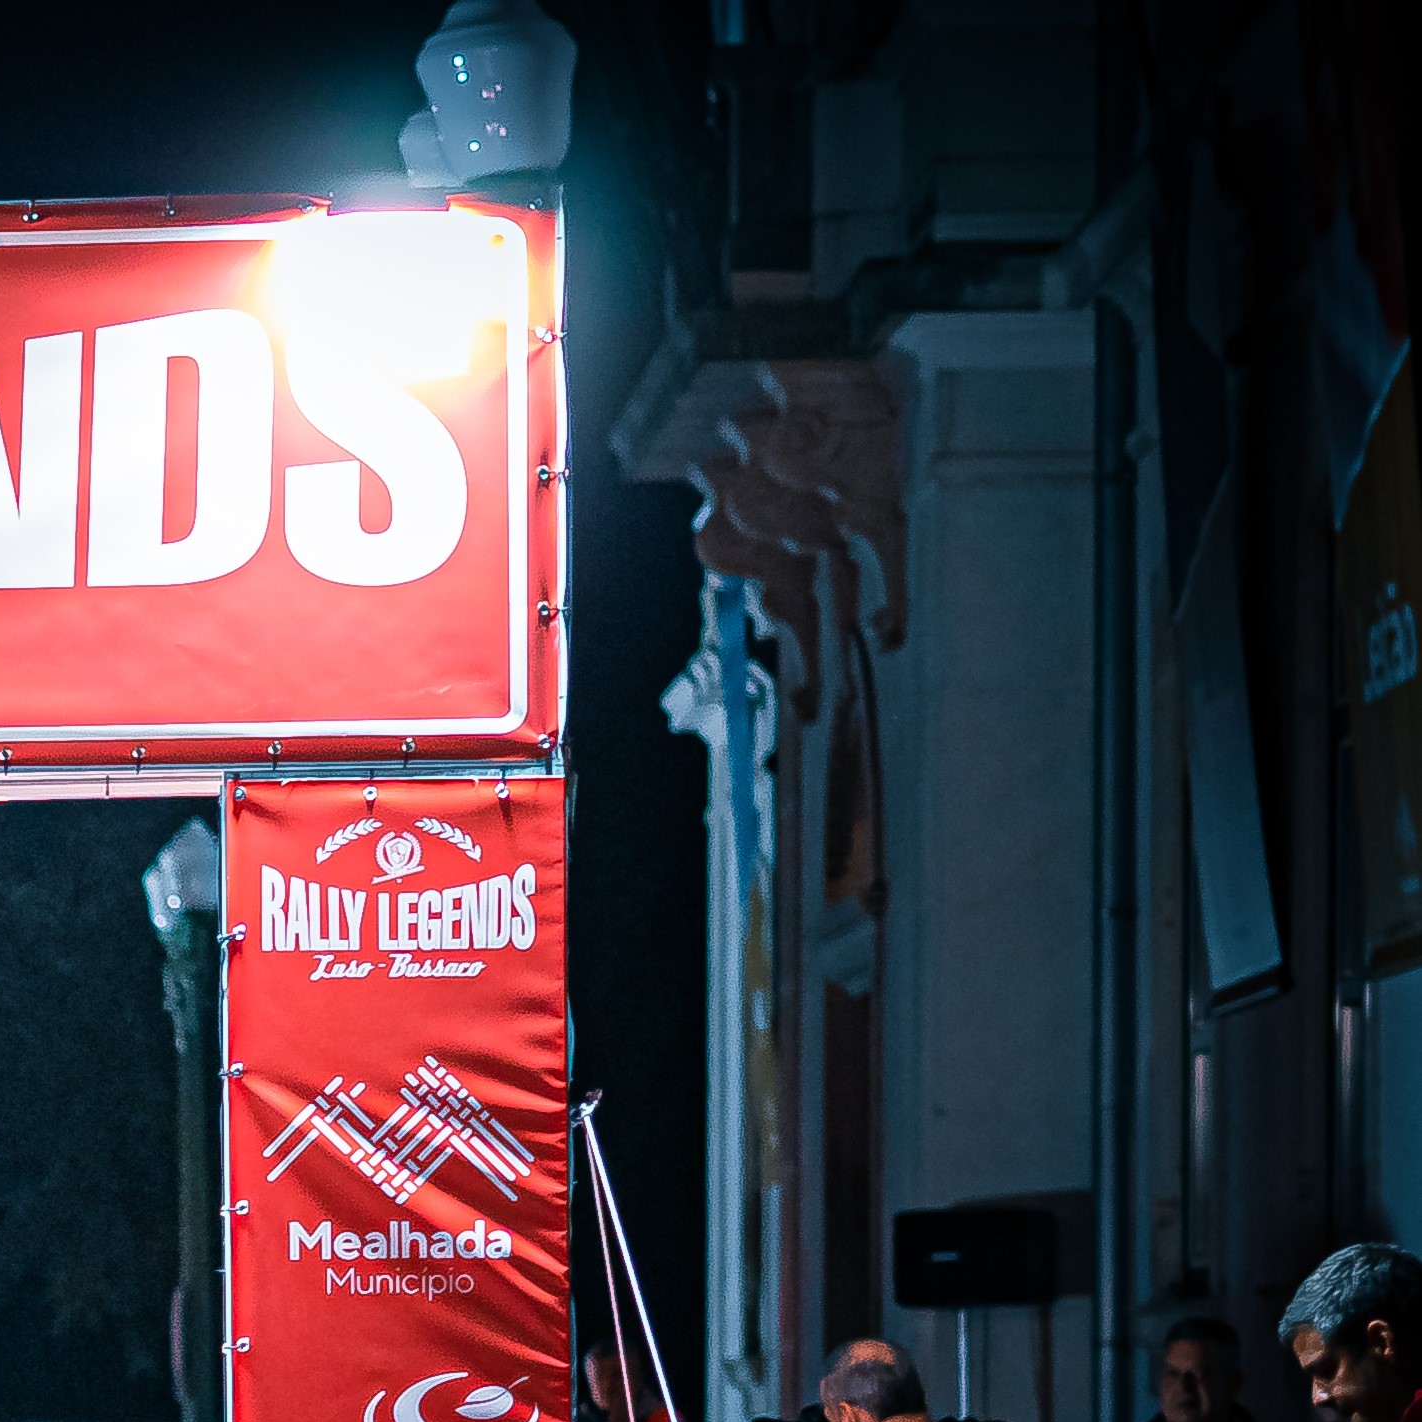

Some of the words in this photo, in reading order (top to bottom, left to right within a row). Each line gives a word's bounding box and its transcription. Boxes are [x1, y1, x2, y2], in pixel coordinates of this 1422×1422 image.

[261, 864, 366, 952] RALLY
[377, 863, 537, 952] LEGENDS
[309, 953, 374, 981] Luso
[387, 952, 487, 979] Bussaco
[288, 1219, 513, 1262] Mealhada
[325, 1267, 475, 1301] Município
